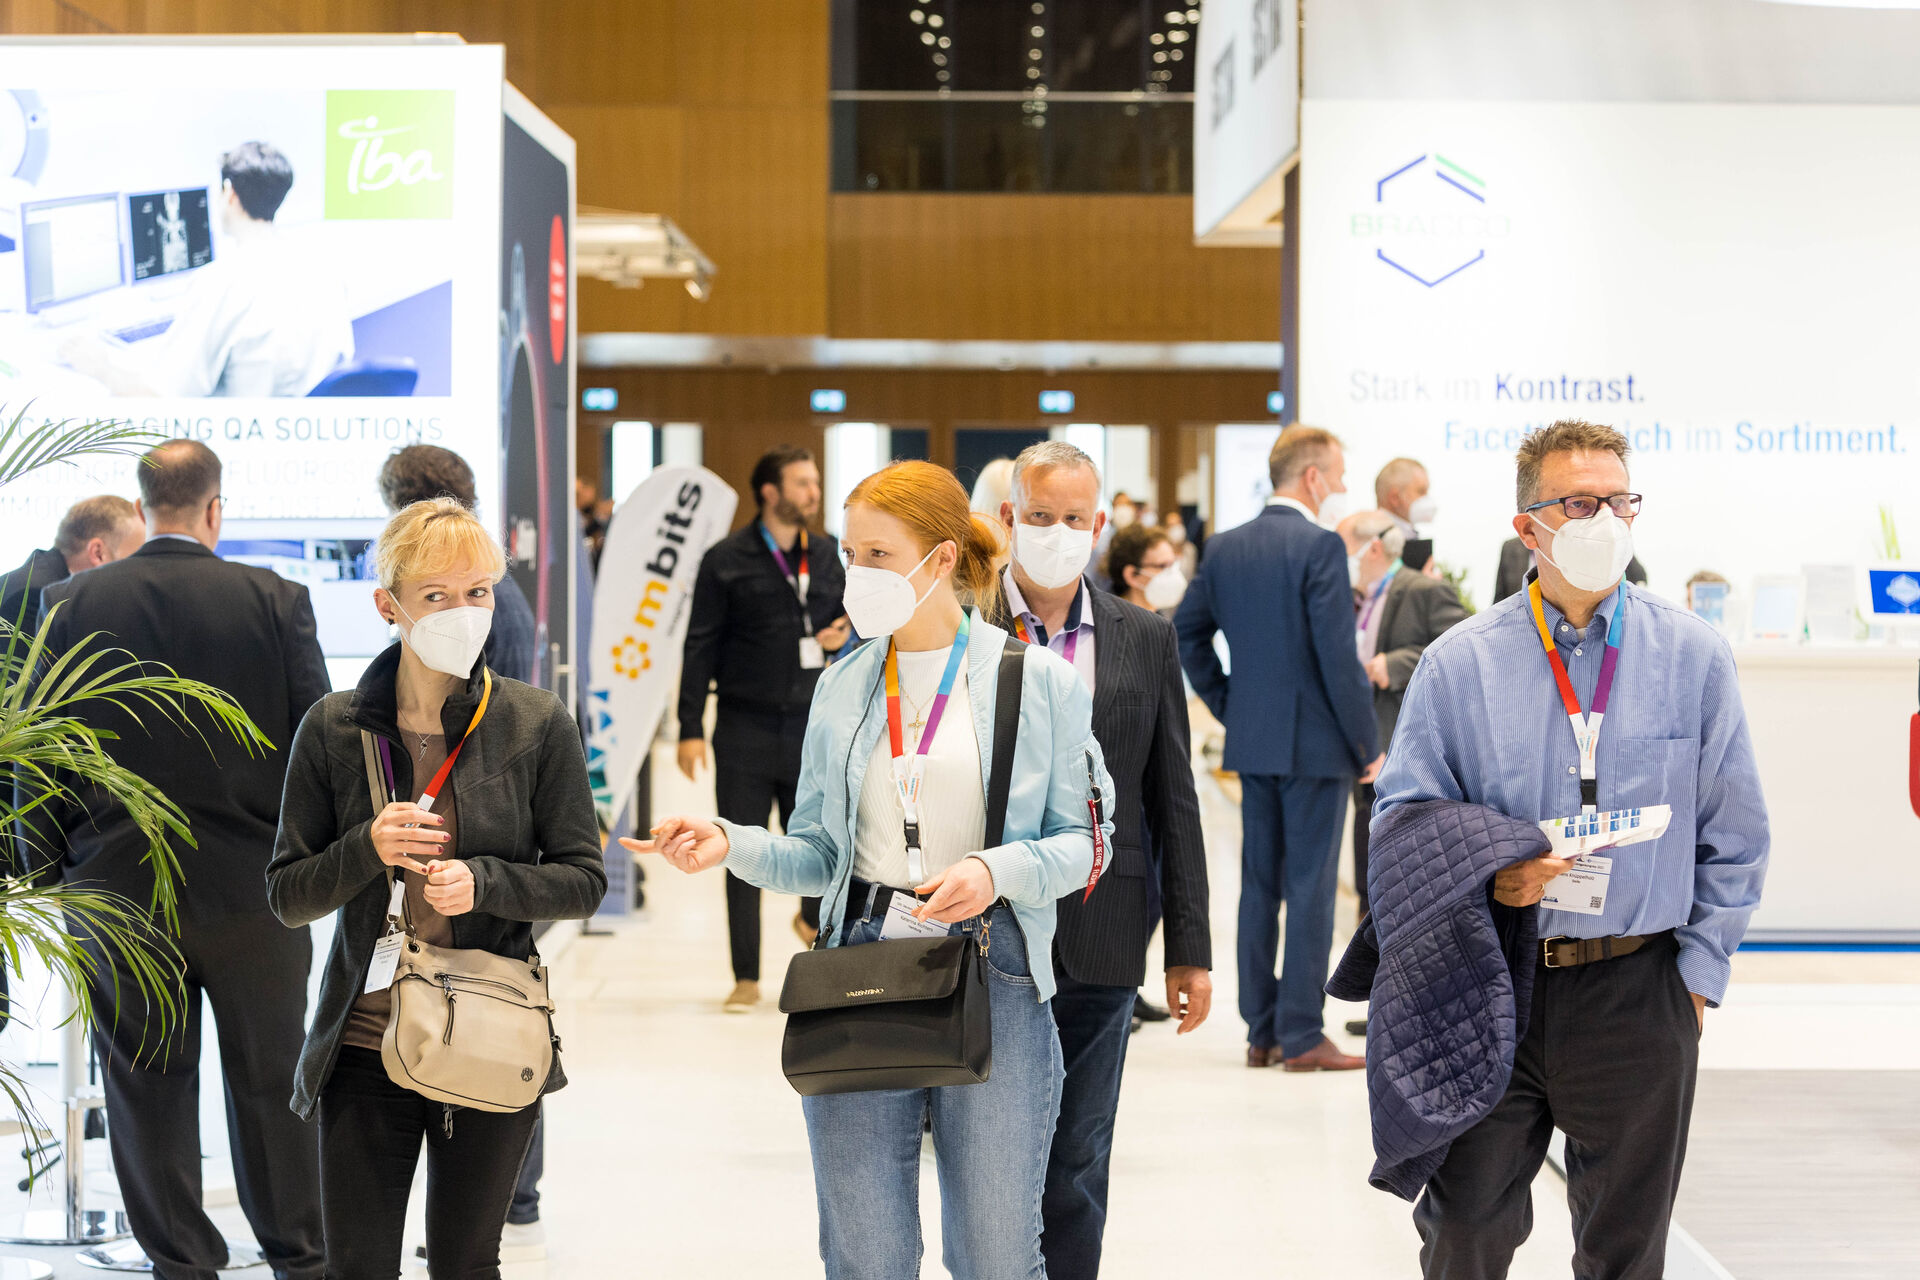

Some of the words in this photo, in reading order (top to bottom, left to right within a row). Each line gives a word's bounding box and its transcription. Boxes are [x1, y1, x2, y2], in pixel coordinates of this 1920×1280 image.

[338, 115, 444, 195] iba
[1350, 213, 1512, 237] BRACCO
[1350, 370, 1431, 402] Stark
[1443, 373, 1481, 402] im
[1495, 371, 1646, 403] Kontrast.
[0, 417, 72, 441] ICAL
[224, 416, 265, 441] QA
[275, 416, 444, 441] SOLUTIONS
[1686, 423, 1722, 454] im
[1735, 421, 1908, 455] Sortiment.
[633, 479, 705, 629] mbits
